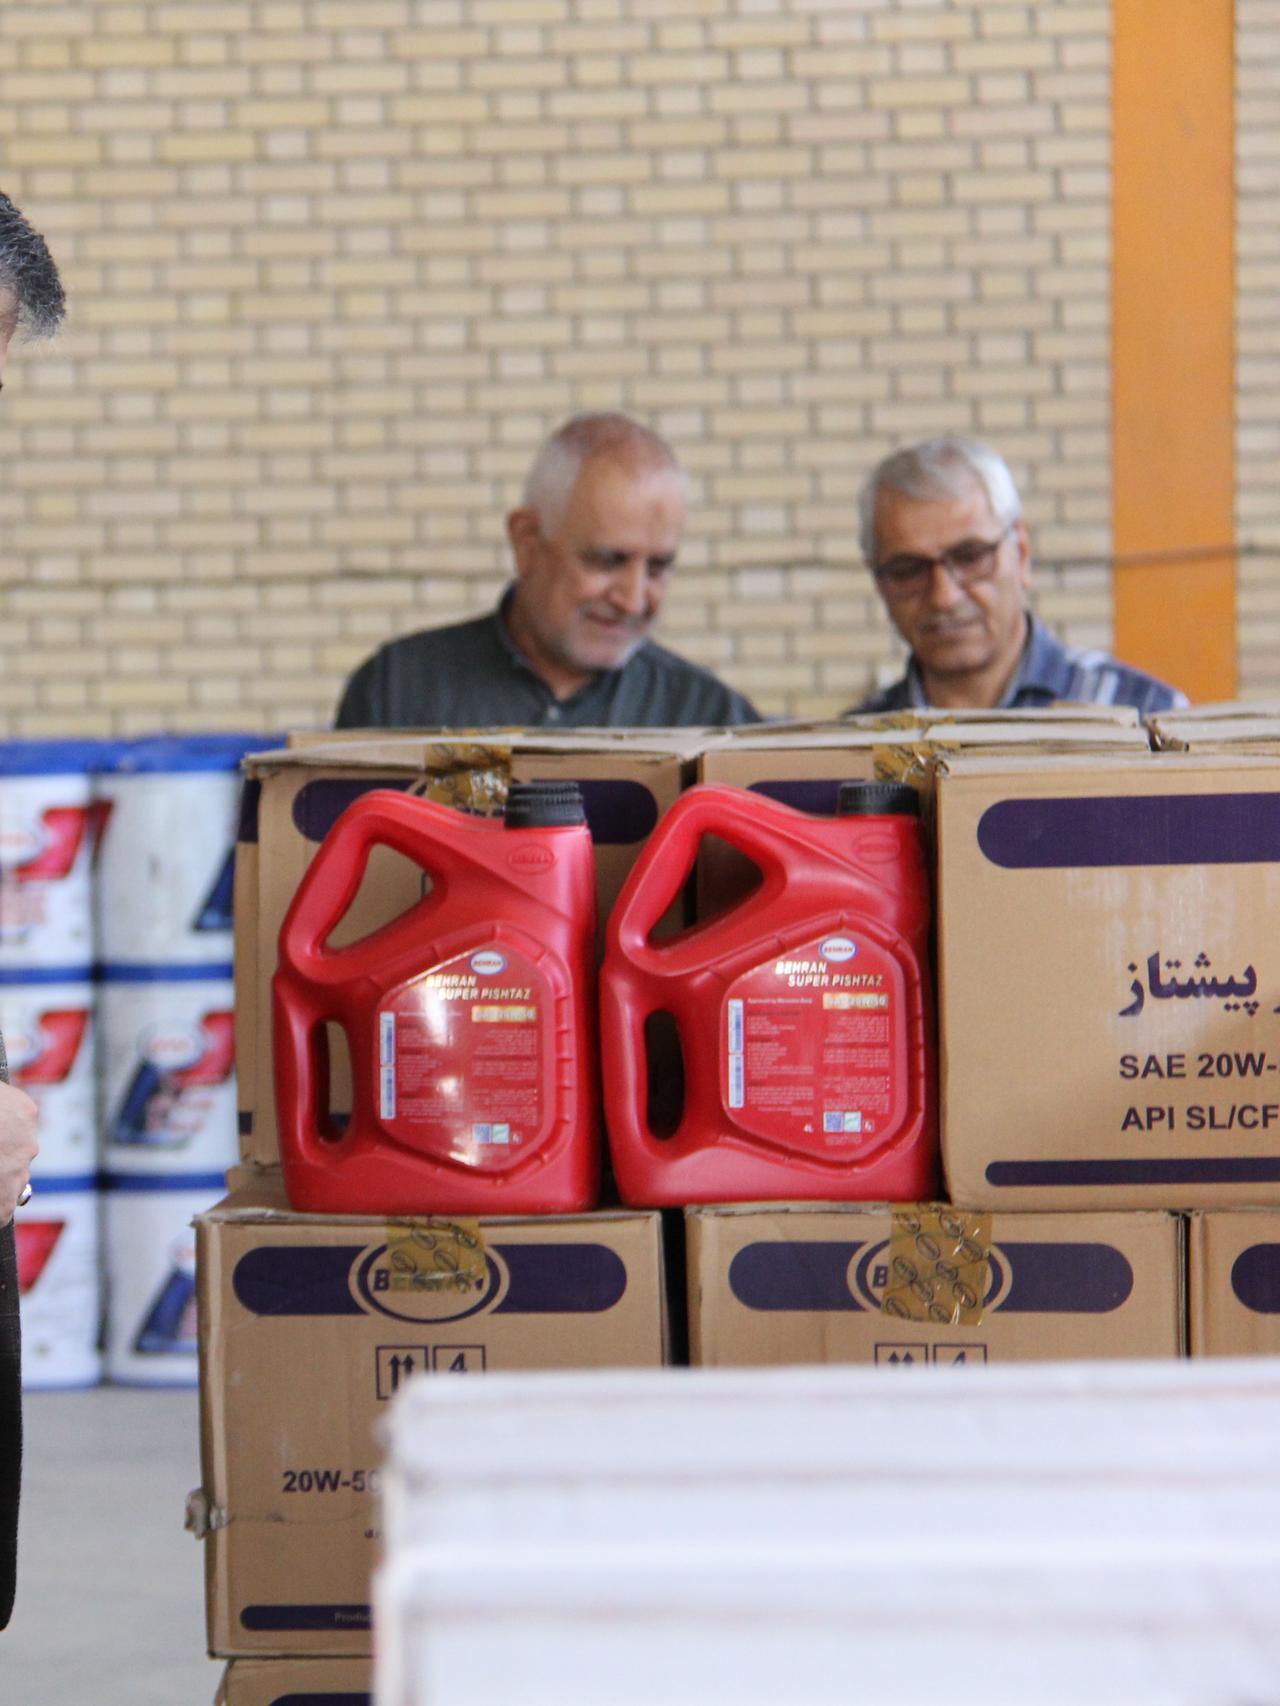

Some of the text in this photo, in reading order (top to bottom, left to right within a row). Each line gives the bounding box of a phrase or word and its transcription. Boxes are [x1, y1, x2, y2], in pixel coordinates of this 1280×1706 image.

[775, 961, 827, 975] BEHRAN
[788, 974, 883, 988] SUPER PISHTAZ
[1118, 951, 1260, 1018] پیشتاز
[480, 987, 531, 1000] PISHTAZ
[1120, 1052, 1280, 1079] SAE 20W-
[1121, 1104, 1279, 1131] API SL/CF
